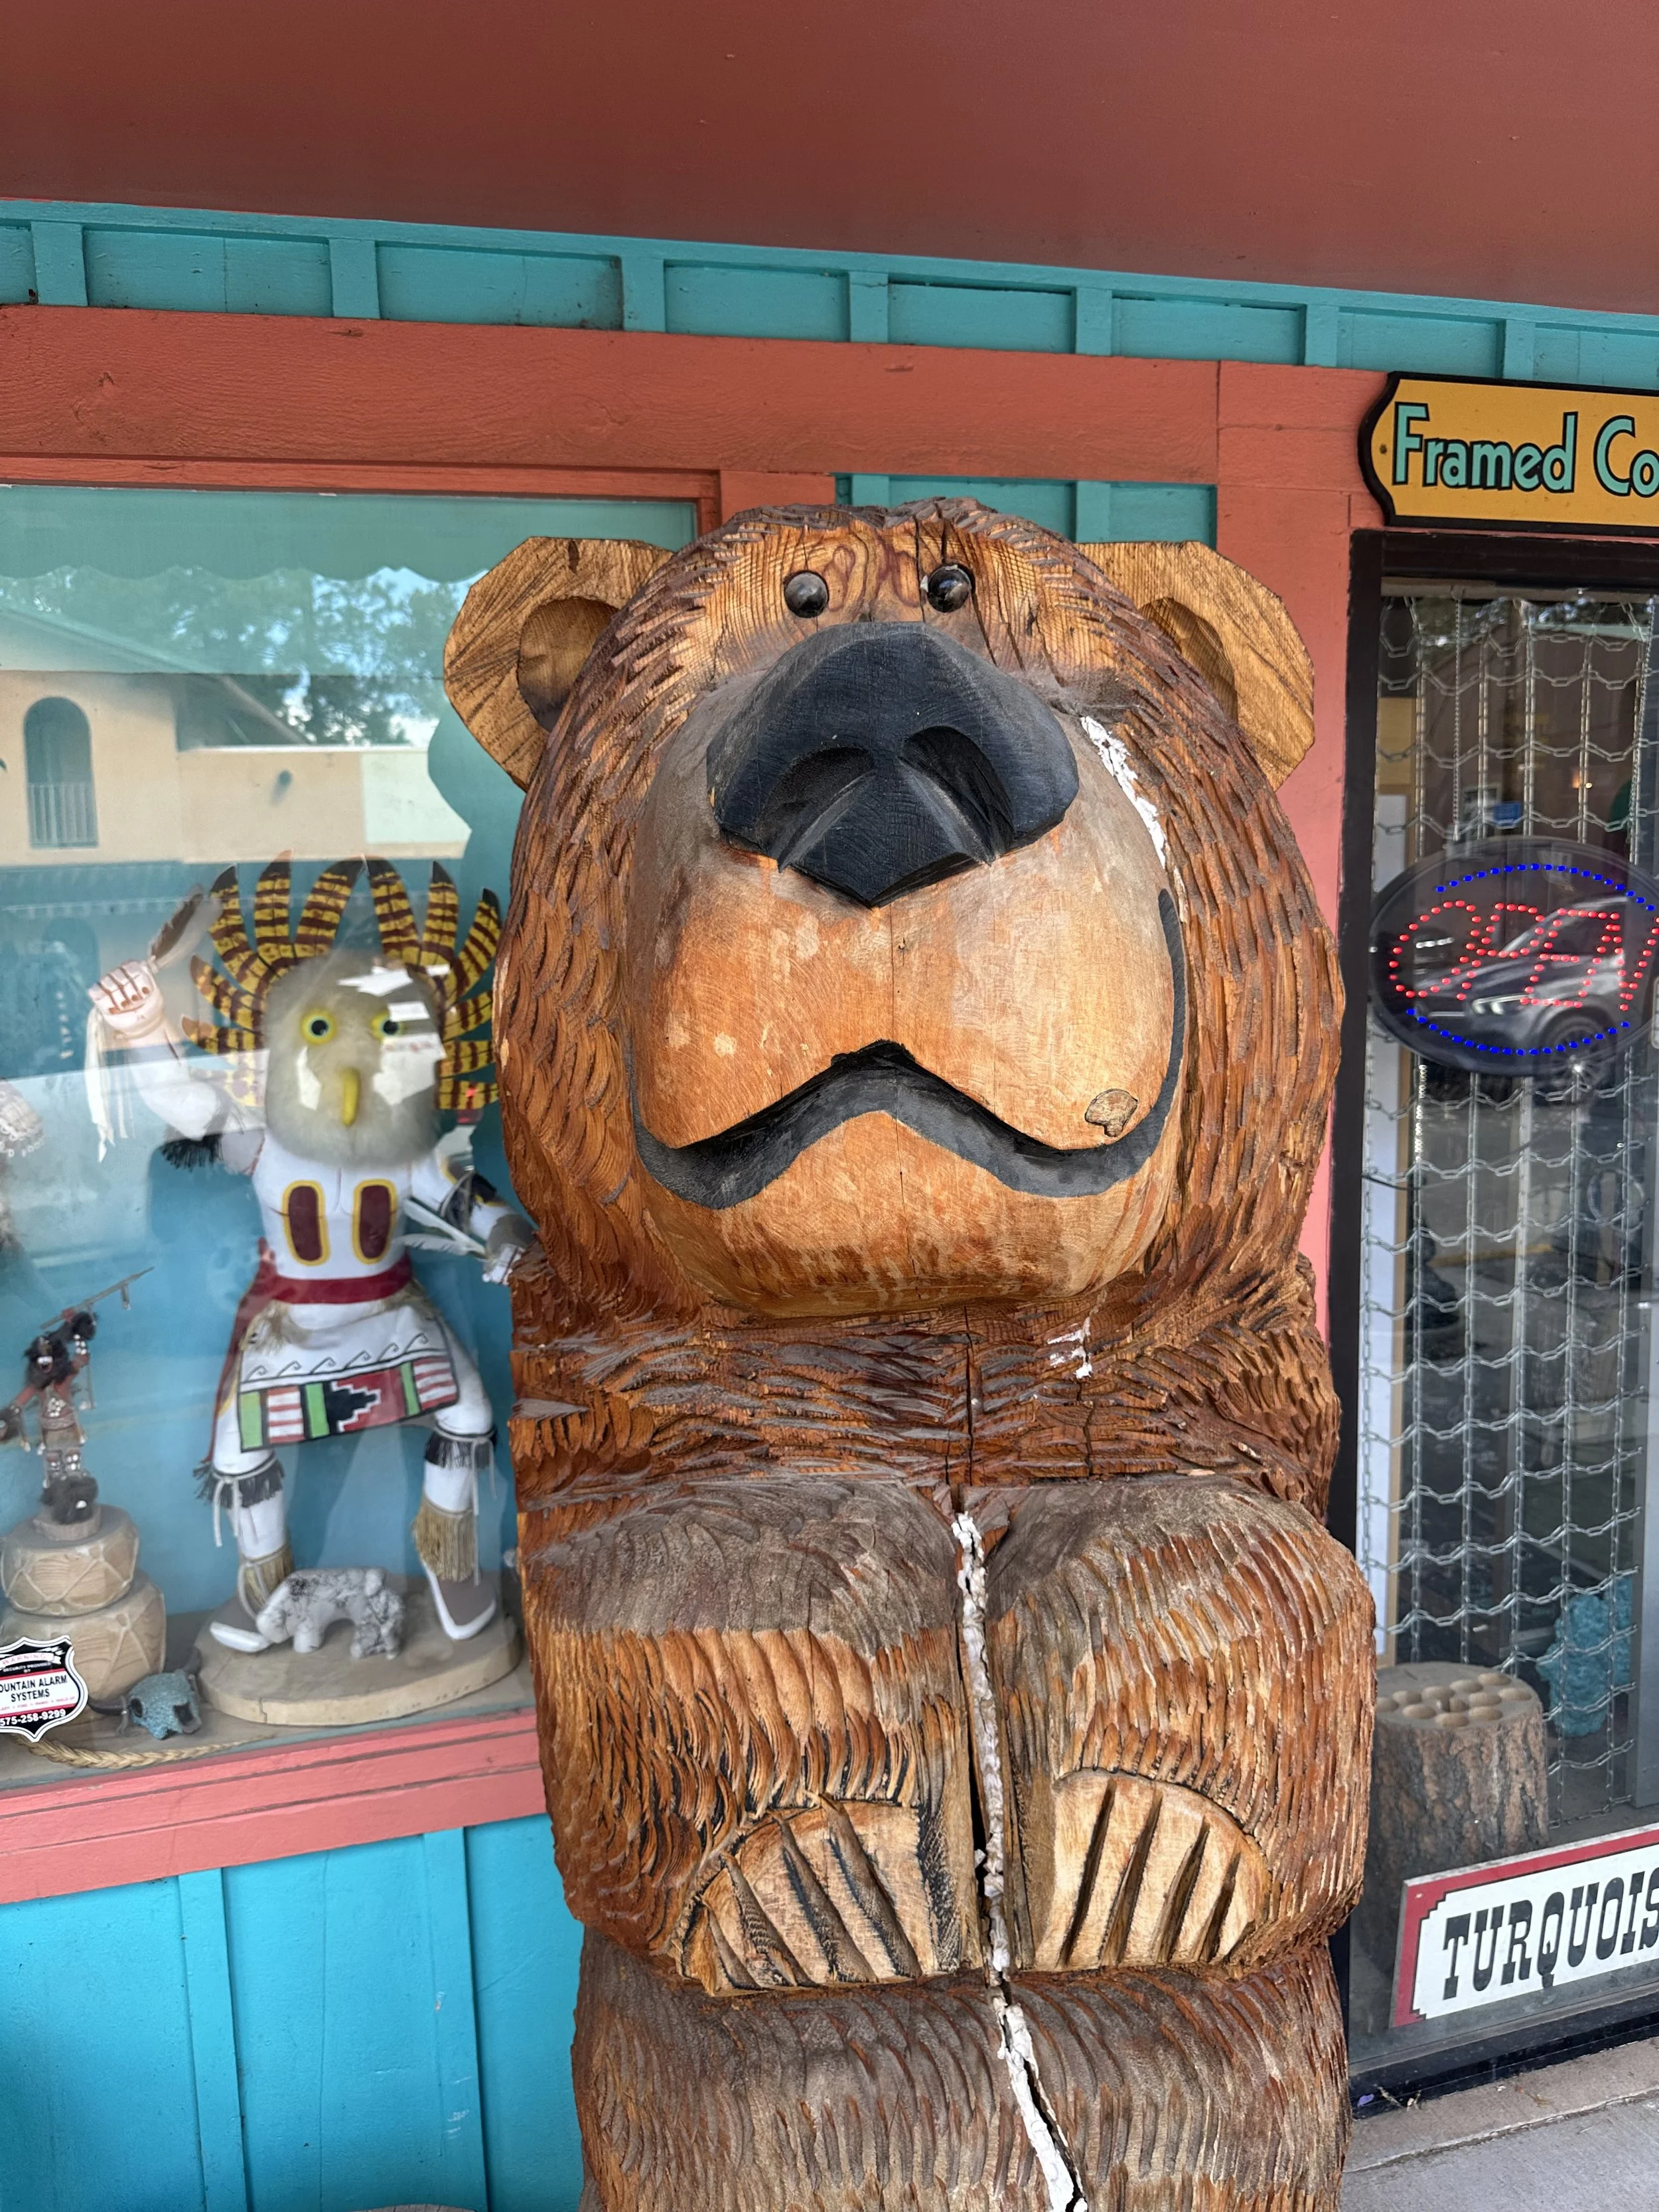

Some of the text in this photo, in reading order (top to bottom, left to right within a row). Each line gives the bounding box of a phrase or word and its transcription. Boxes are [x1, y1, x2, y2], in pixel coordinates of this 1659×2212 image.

[1392, 401, 1659, 498] Framed Co
[1389, 899, 1659, 1012] OPEN
[11, 1688, 50, 1702] SYSTEMS
[39, 1674, 67, 1686] ALARM
[0, 1709, 66, 1726] 575-258-9299
[1443, 1867, 1659, 2001] TURQUOIS
